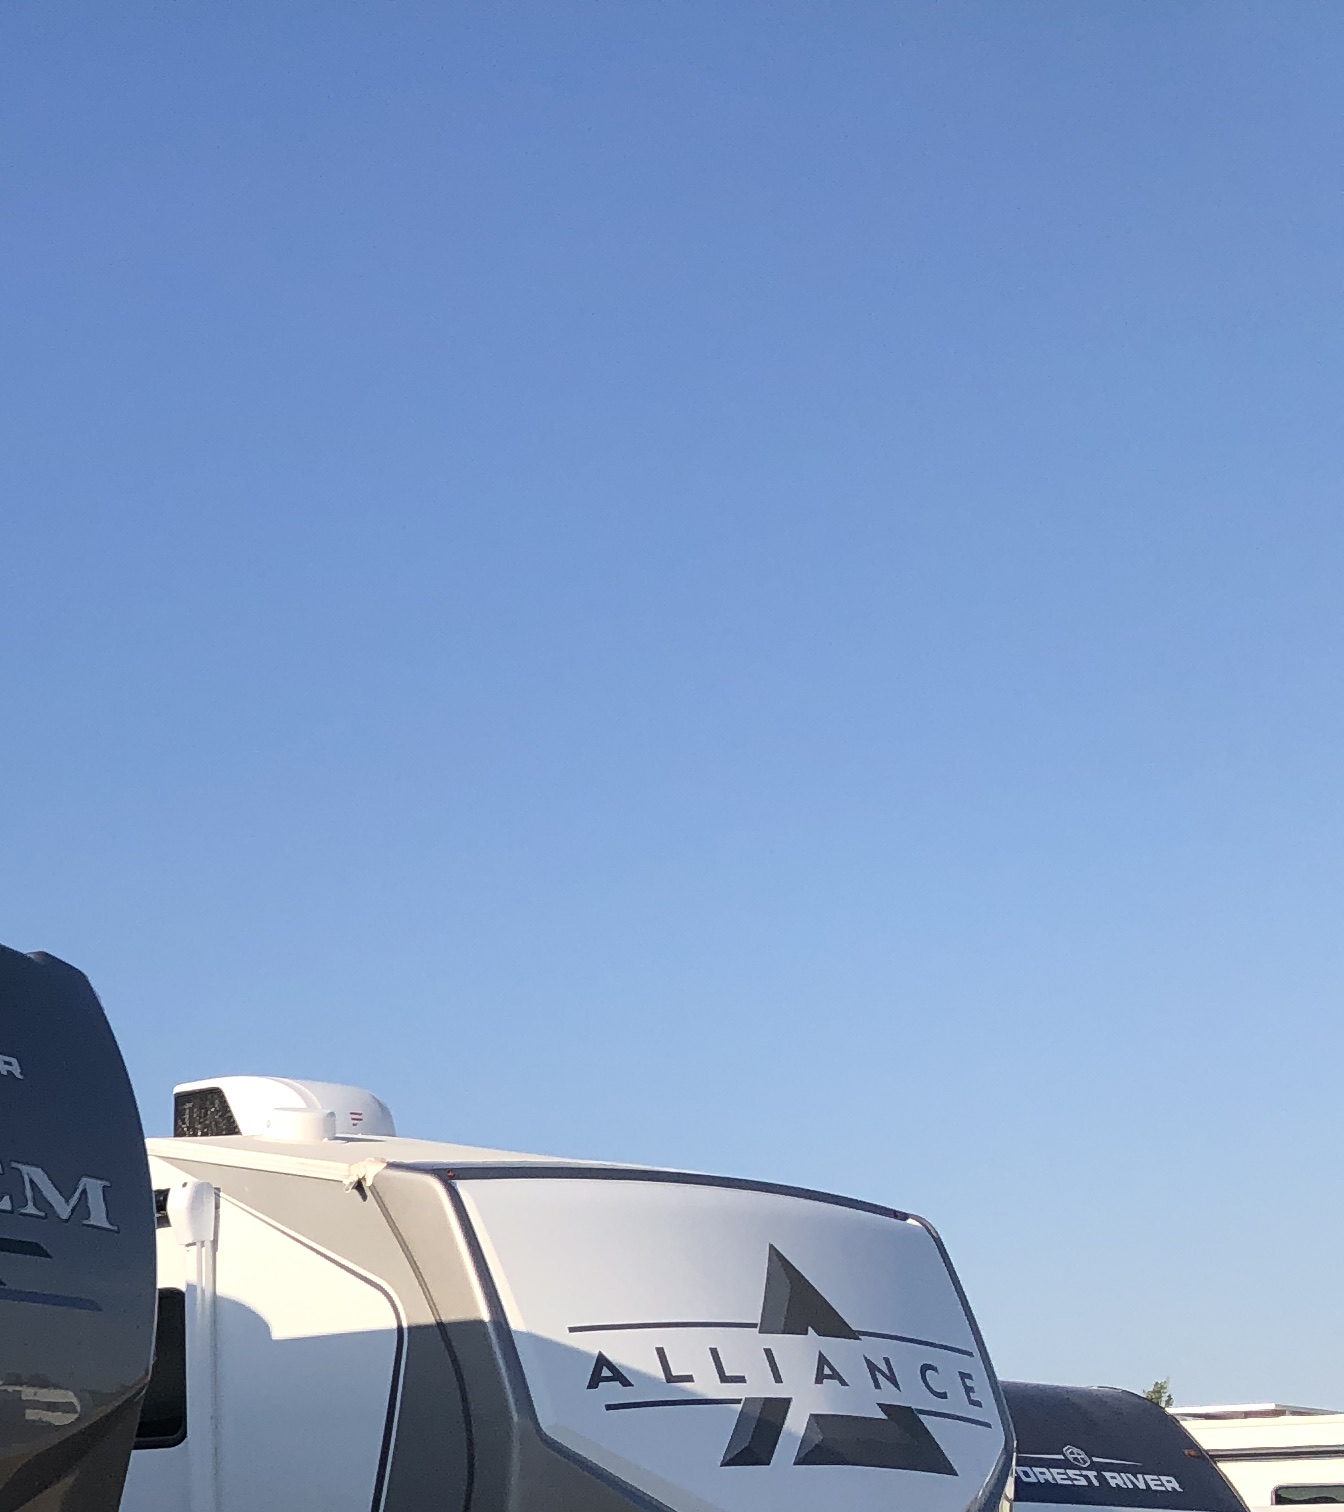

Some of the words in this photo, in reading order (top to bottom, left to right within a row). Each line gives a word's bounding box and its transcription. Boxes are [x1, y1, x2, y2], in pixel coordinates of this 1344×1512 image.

[586, 1346, 984, 1409] ALLIANCE
[1014, 1466, 1100, 1487] OREST
[1101, 1471, 1183, 1492] RIVER
